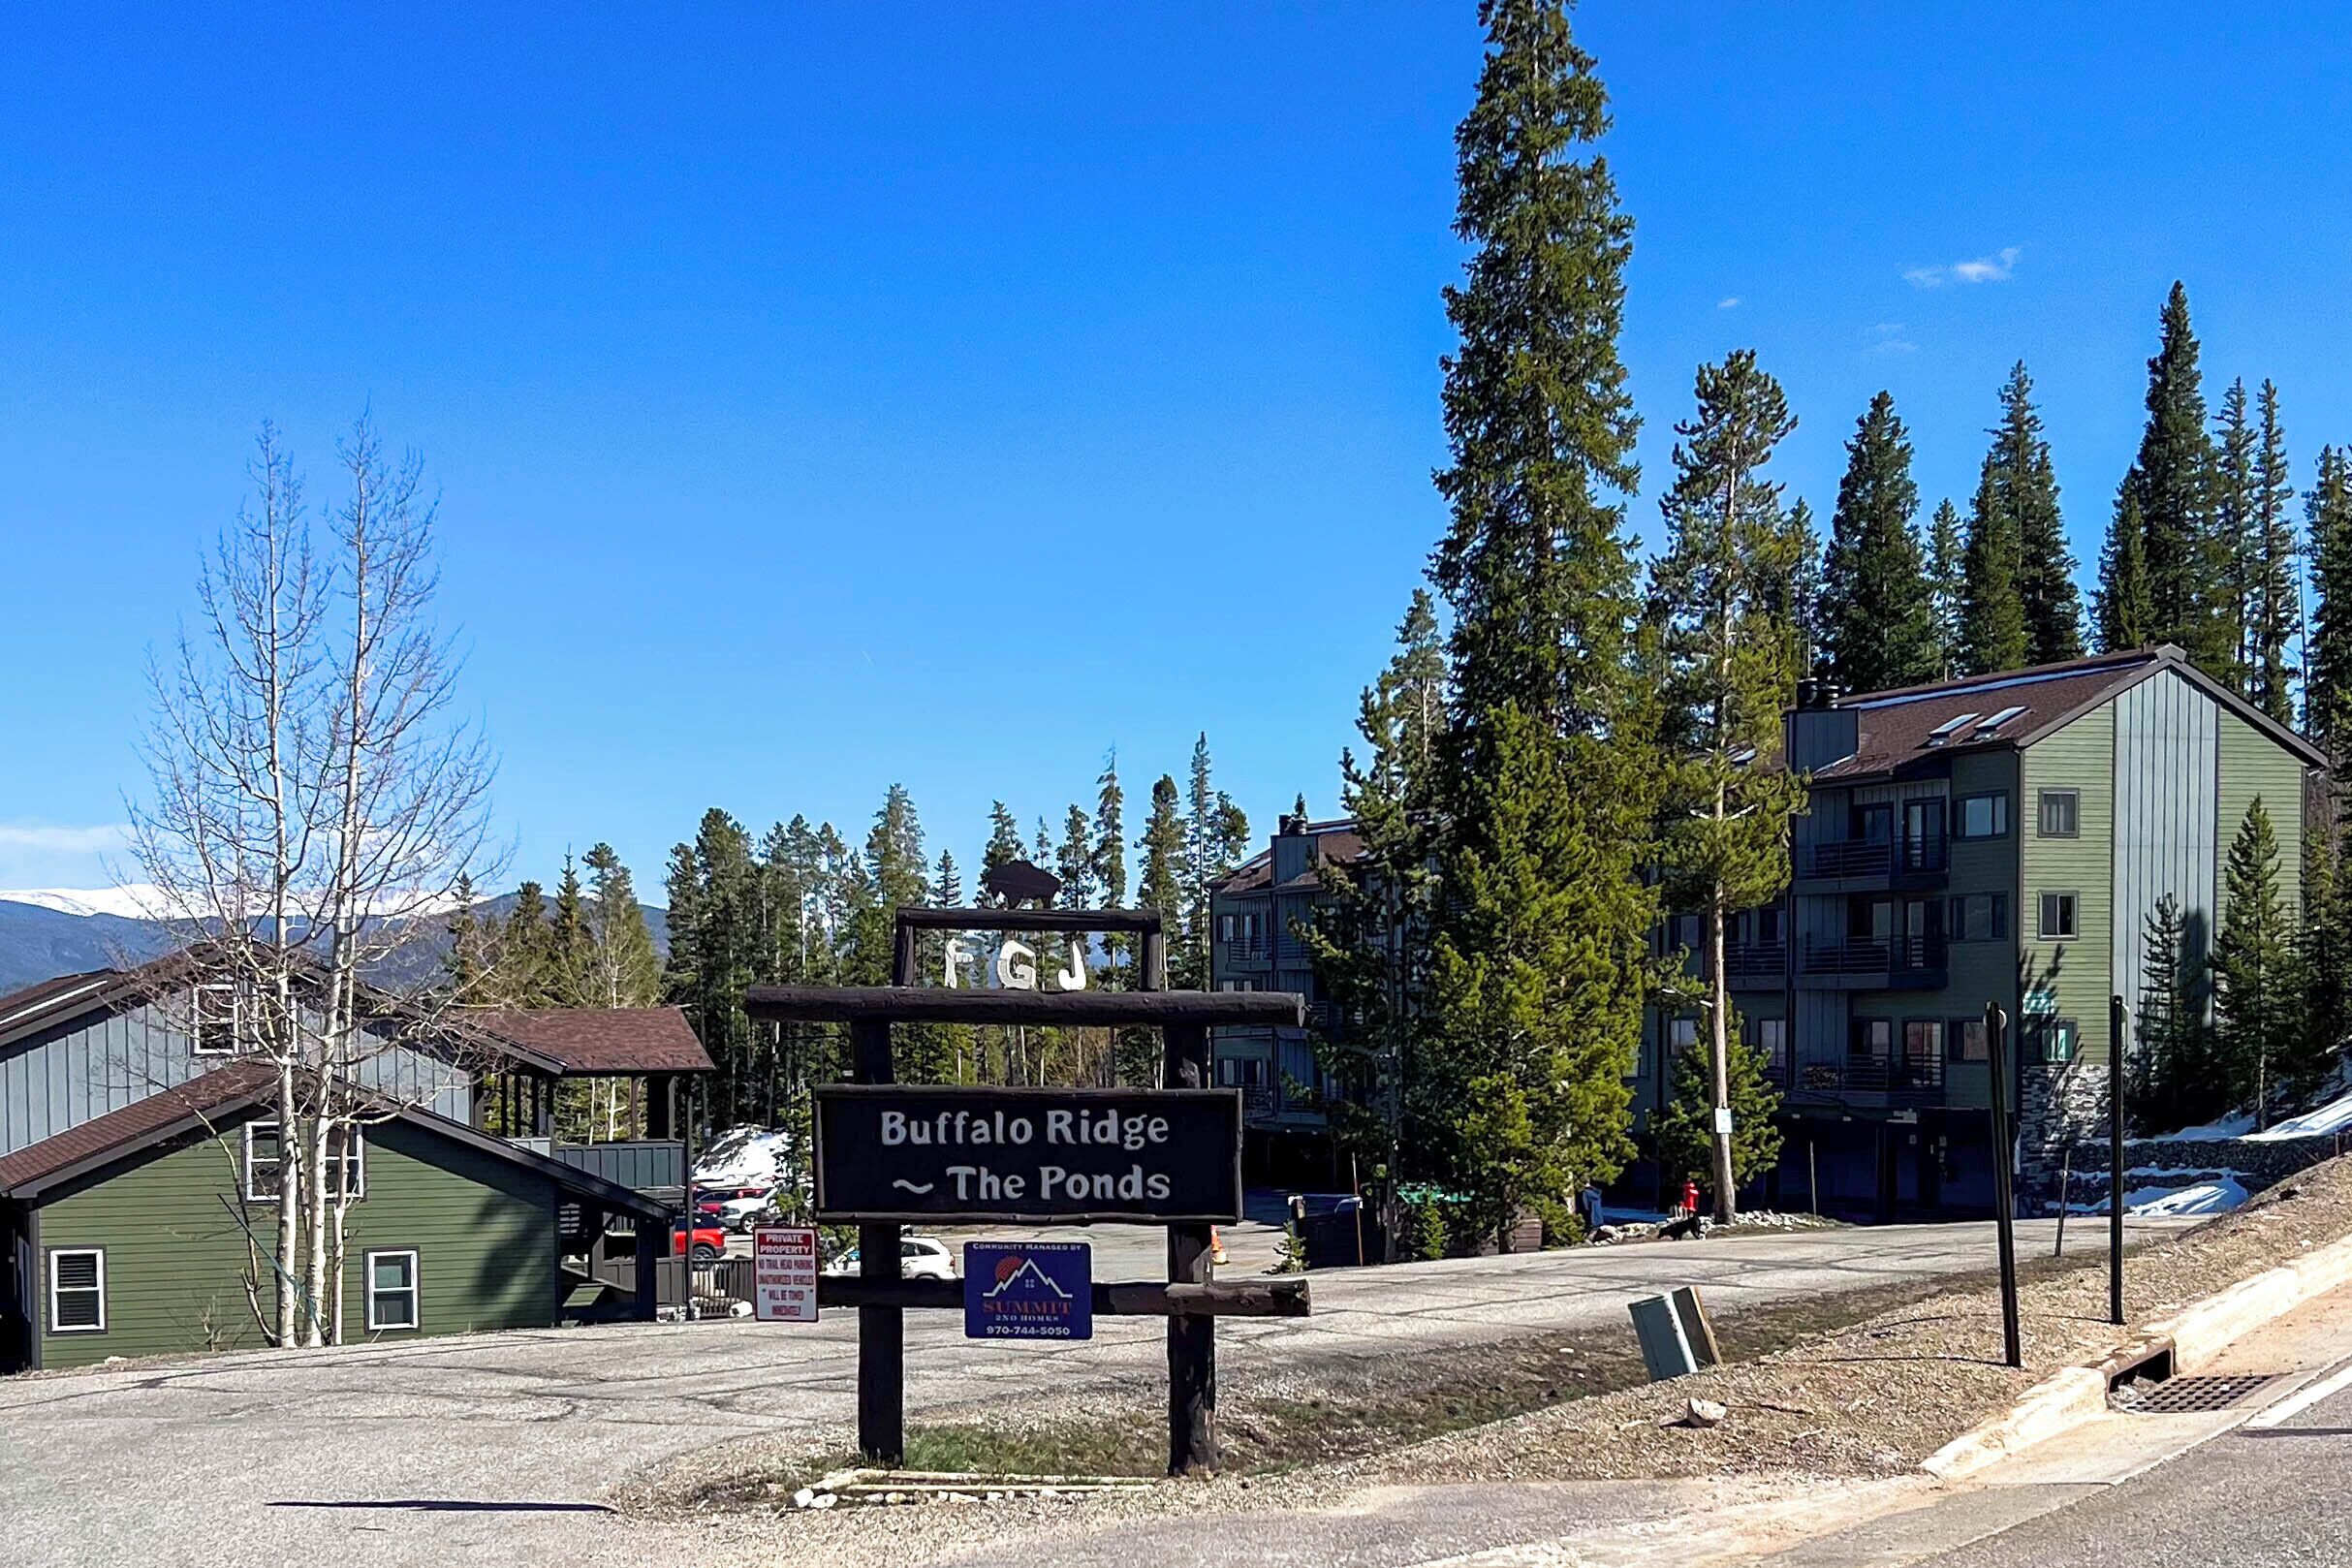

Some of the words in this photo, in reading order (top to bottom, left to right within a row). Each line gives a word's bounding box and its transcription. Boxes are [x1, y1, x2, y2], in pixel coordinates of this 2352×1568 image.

[881, 1111, 1033, 1145] Buffalo
[1047, 1109, 1169, 1150] Ridge
[946, 1166, 1025, 1201] The
[1039, 1164, 1171, 1200] Ponds
[766, 1234, 803, 1243] PRIVATE
[760, 1245, 810, 1254] PROPERTY
[983, 1301, 1071, 1315] SUMMIT
[986, 1326, 1071, 1335] 970-744-5050
